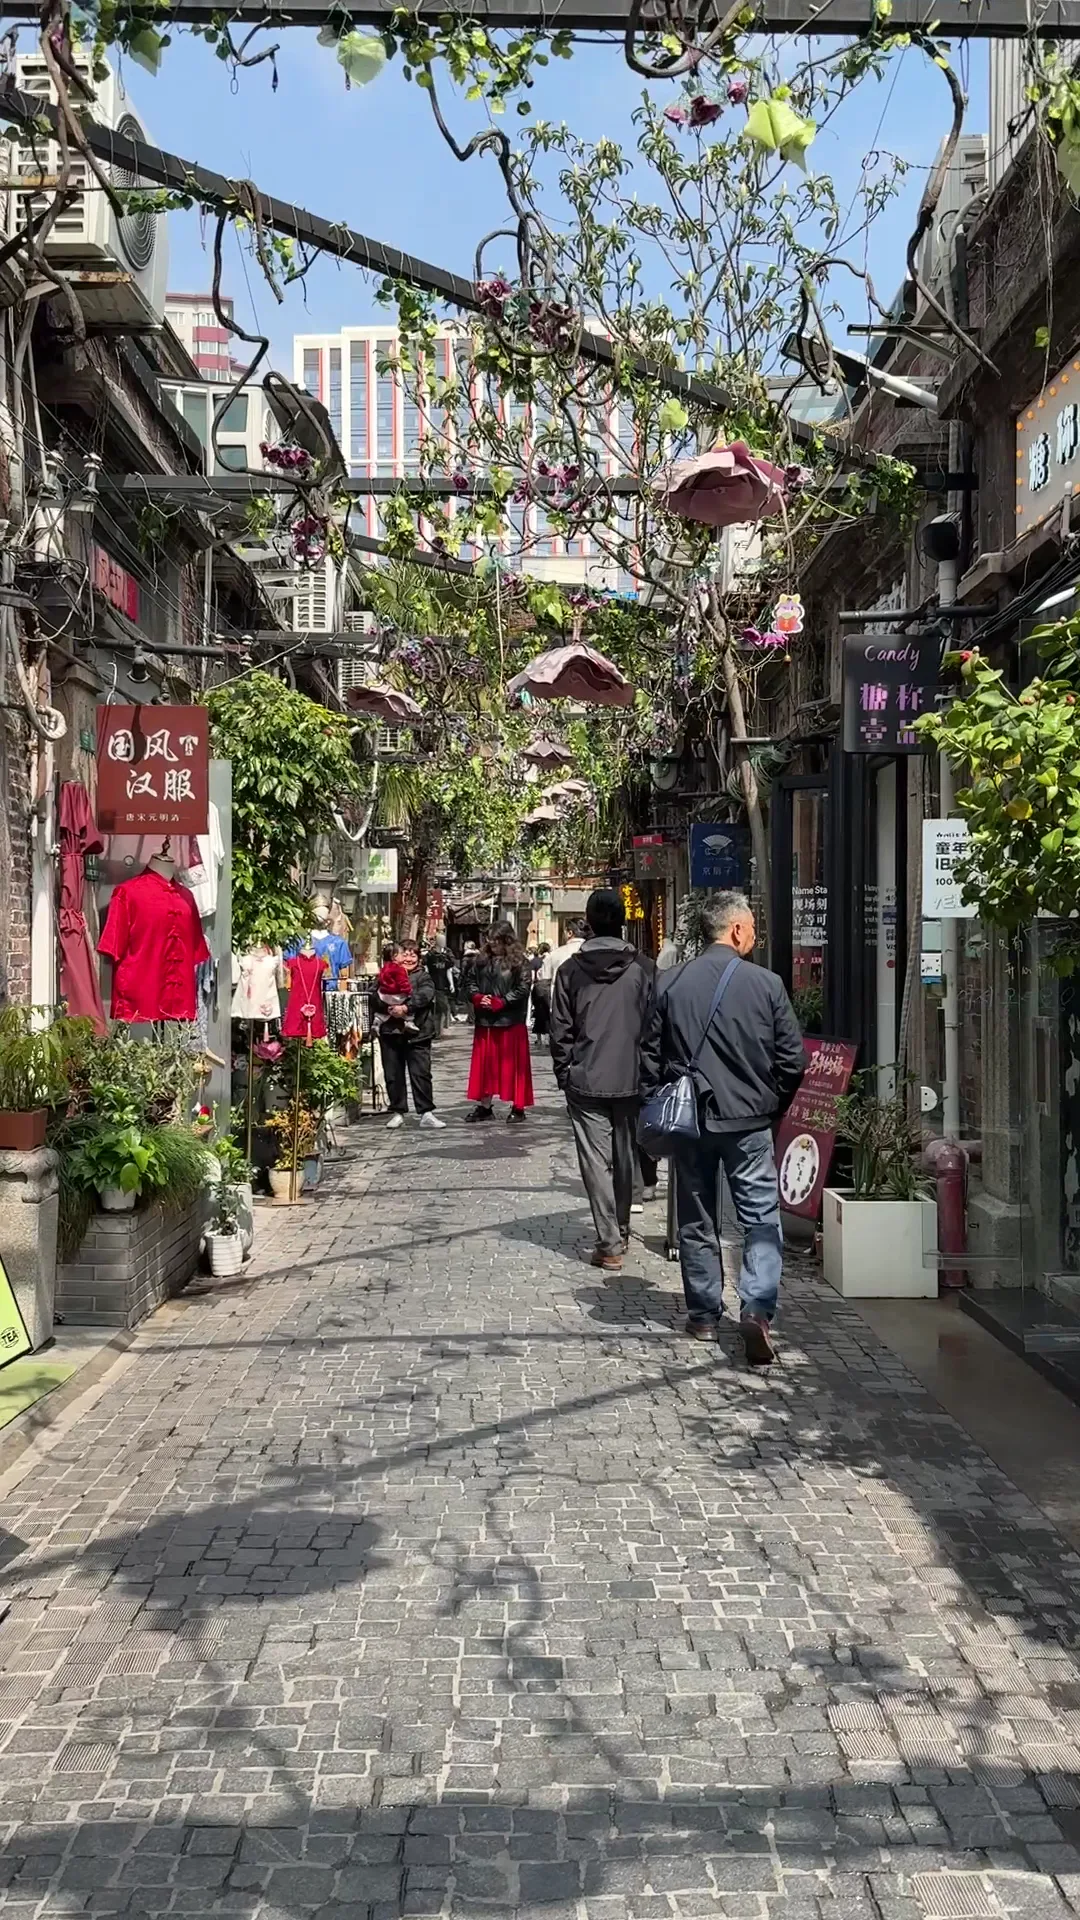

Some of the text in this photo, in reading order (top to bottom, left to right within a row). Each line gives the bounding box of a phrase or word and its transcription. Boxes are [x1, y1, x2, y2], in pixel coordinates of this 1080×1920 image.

[864, 642, 920, 671] Candy
[108, 729, 180, 762] 国风
[126, 768, 196, 803] 汉服
[792, 886, 814, 896] Name
[792, 898, 828, 911] 现场刻
[793, 913, 827, 926] 立等可
[1, 1330, 19, 1345] TEA
